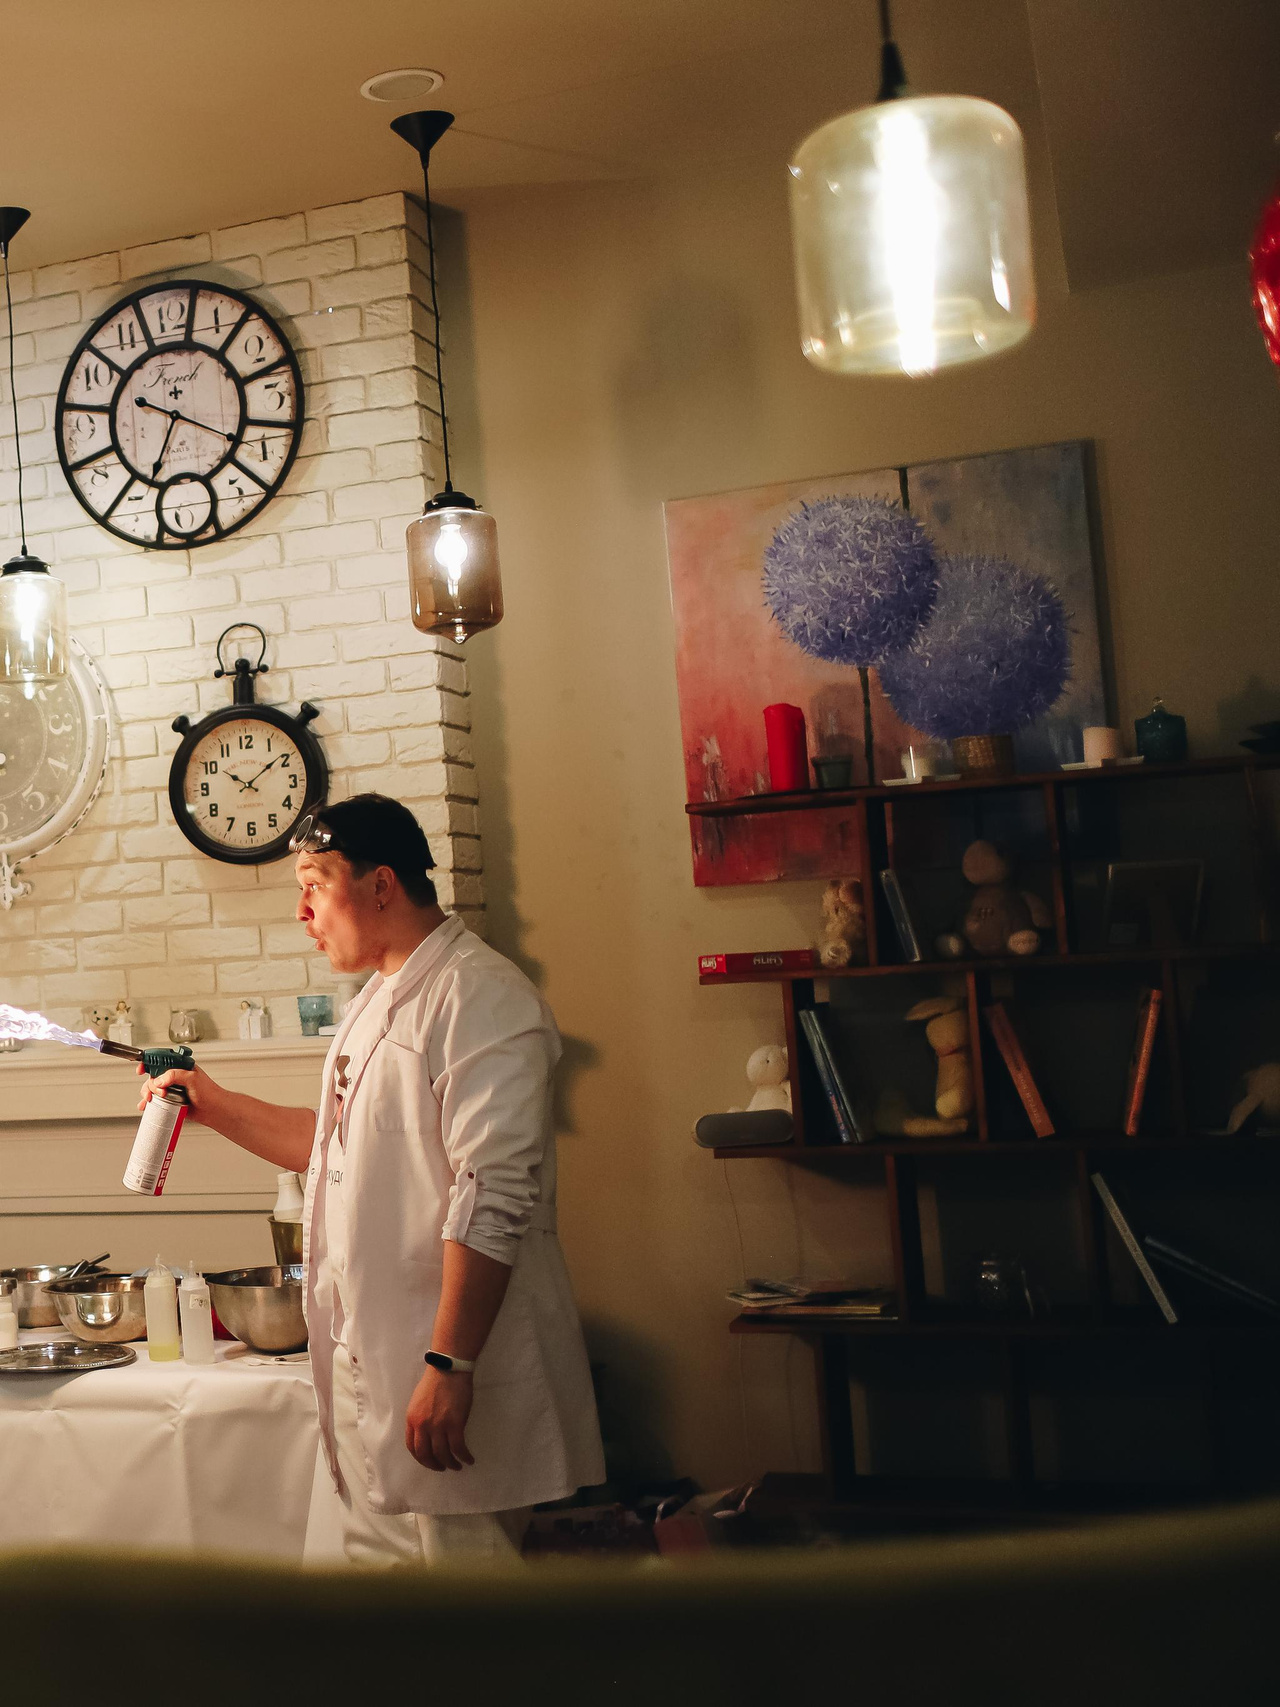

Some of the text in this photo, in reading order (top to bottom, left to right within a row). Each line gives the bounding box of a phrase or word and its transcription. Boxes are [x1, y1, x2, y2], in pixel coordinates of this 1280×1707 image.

[157, 299, 186, 334] 12
[213, 306, 220, 334] 1
[117, 321, 136, 351] 11
[244, 334, 266, 364] 2
[84, 363, 115, 391] 10
[143, 361, 205, 389] French
[264, 381, 285, 412] 3
[76, 413, 96, 442] 9
[91, 460, 109, 488] 8
[224, 476, 244, 507] 5
[174, 500, 195, 529] 6
[49, 712, 73, 734] 3
[220, 743, 230, 758] 11
[239, 734, 254, 750] 12
[267, 738, 272, 752] 1
[47, 755, 69, 779] 4
[204, 760, 218, 775] 10
[280, 753, 290, 767] 2
[200, 782, 210, 796] 9
[288, 773, 298, 788] 3
[22, 784, 45, 811] 5
[281, 794, 293, 810] 4
[209, 803, 219, 817] 8
[268, 813, 277, 828] 5
[226, 817, 235, 832] 7
[246, 821, 257, 836] 6
